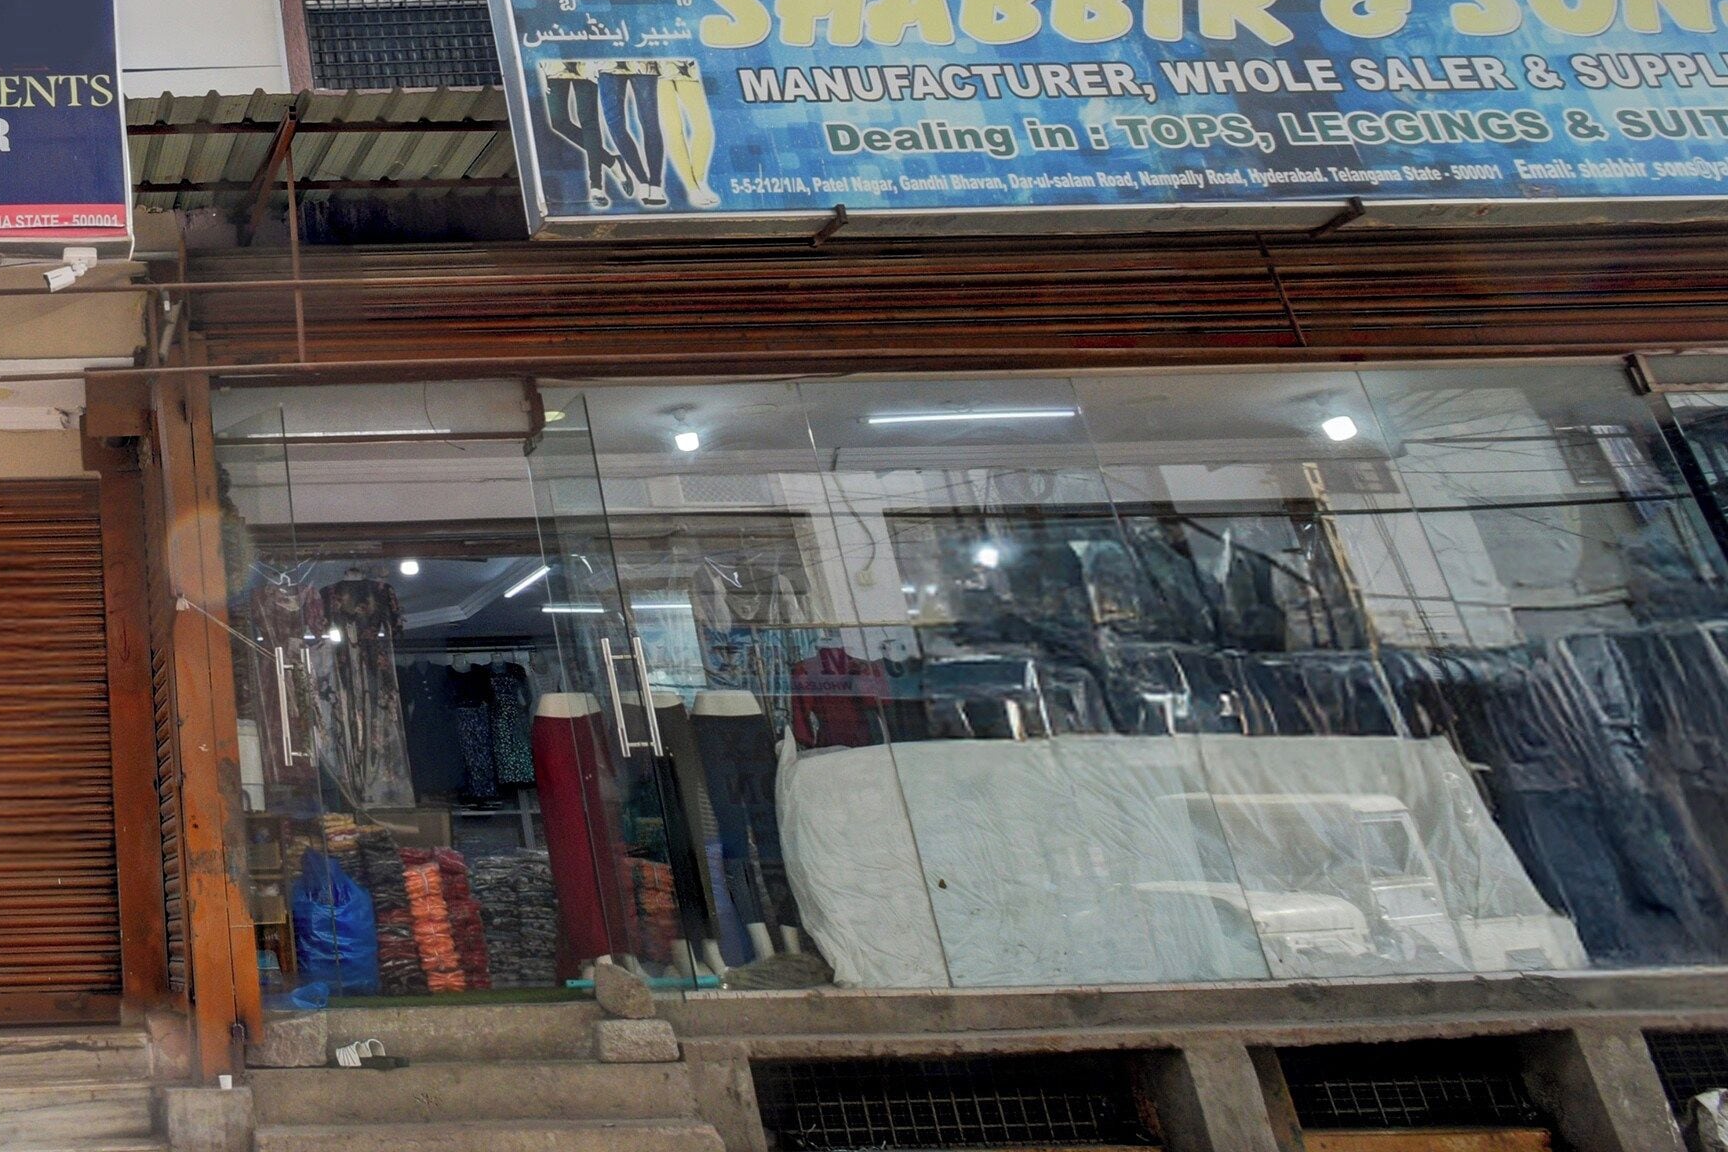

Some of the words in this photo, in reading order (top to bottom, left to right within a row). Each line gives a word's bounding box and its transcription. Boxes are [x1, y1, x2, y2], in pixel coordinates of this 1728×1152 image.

[740, 61, 1157, 104] MANUFACTURER,
[1159, 58, 1346, 95] WHOLE
[1354, 55, 1511, 93] SALER
[1523, 54, 1565, 89] &
[1570, 52, 1728, 89] SUPPL
[826, 120, 1017, 159] Dealing
[1028, 119, 1078, 151] in
[1117, 113, 1276, 153] TOPS,
[1278, 108, 1549, 149] LEGGINGS
[1565, 109, 1609, 142] &
[813, 177, 849, 194] Patel
[852, 177, 898, 196] Nagar,
[900, 174, 947, 192] Gandhi
[951, 173, 1007, 192] Bhavan,
[1011, 171, 1096, 190] Dar-ul-salam
[1096, 171, 1138, 190] Road,
[1140, 170, 1205, 190] Nampally
[1206, 168, 1248, 188] Road,
[1328, 165, 1402, 186] Telangana
[1405, 165, 1442, 182] State
[1453, 163, 1503, 181] 500001
[1514, 158, 1576, 180] Email:
[15, 214, 59, 227] STATE
